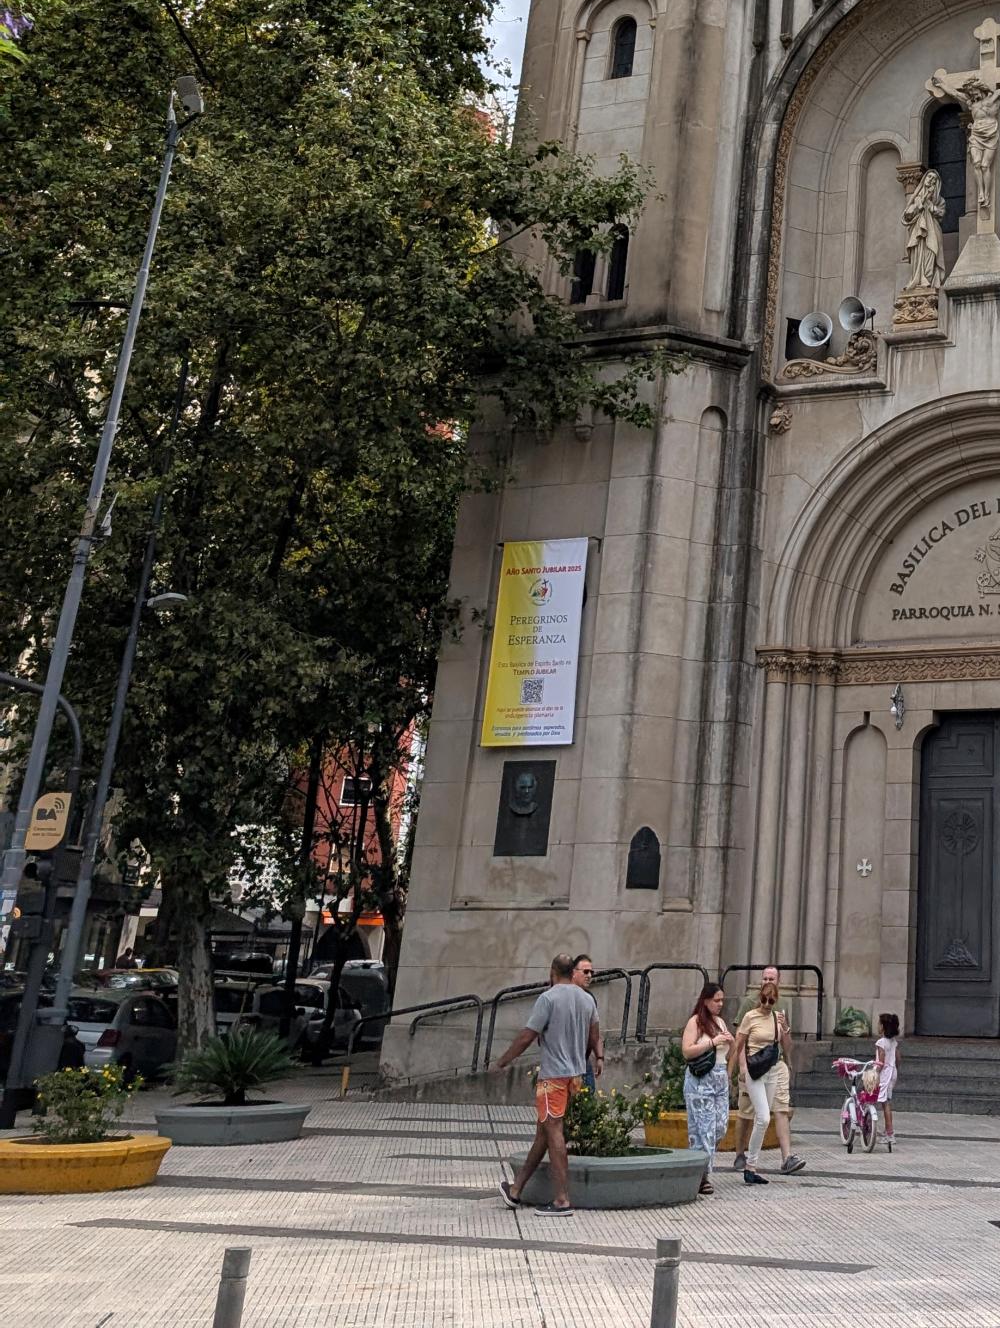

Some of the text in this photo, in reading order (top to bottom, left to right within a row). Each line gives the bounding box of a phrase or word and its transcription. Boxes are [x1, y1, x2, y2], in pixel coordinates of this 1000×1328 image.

[890, 520, 955, 597] BASILICA
[954, 501, 992, 527] DEL
[521, 566, 542, 575] SANTO
[542, 565, 567, 574] JUBILAR
[892, 604, 976, 622] PARROQUIA
[979, 603, 994, 617] N.
[509, 615, 568, 626] PEREGRINOS
[533, 625, 543, 633] DE
[507, 634, 567, 646] ESPERANZA
